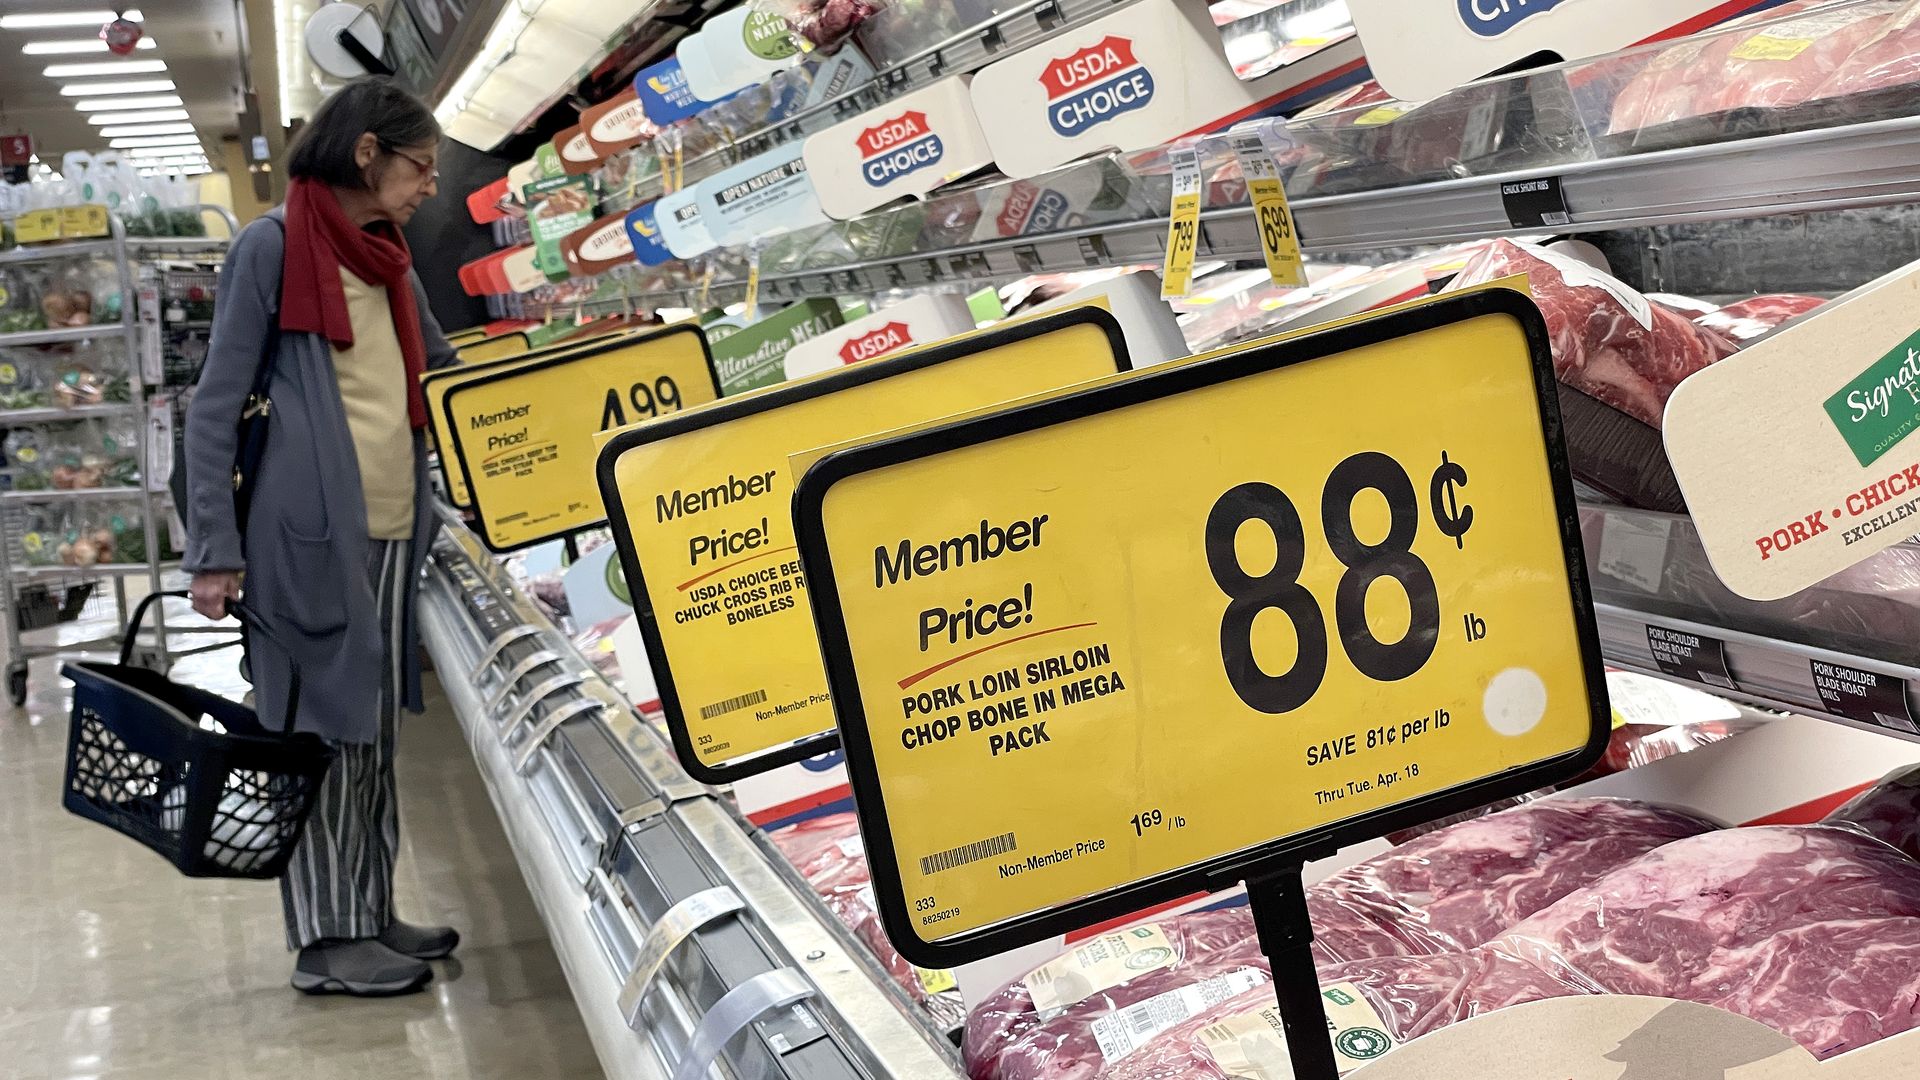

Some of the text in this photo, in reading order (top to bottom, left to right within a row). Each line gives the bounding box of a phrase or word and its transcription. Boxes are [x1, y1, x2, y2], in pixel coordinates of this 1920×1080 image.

[1054, 47, 1123, 89] USDA
[1057, 74, 1150, 129] CHOICE
[867, 117, 918, 153] USDA
[867, 139, 942, 185] CHOICE
[722, 182, 751, 203] OPEN
[749, 168, 787, 192] NATURE
[1503, 180, 1549, 195] CHUCK SHORT RIBS
[1171, 220, 1193, 267] 799
[1261, 206, 1290, 254] 699
[790, 310, 835, 346] MEAT
[851, 329, 901, 361] USDA
[1847, 348, 1920, 422] Signat
[471, 404, 531, 430] Member
[488, 427, 528, 451] Price!
[1874, 420, 1912, 452] QUALITY
[656, 470, 776, 523] Member
[689, 518, 769, 566] Price!
[875, 514, 1048, 588] Member
[1756, 510, 1829, 561] PORK
[675, 600, 721, 624] CHUCK
[724, 588, 767, 610] CROSS
[770, 578, 793, 595] RIB
[690, 582, 726, 602] USDA
[729, 567, 777, 593] CHOICE
[727, 596, 795, 626] BONELESS
[920, 582, 1033, 651] Price!
[1463, 613, 1486, 642] lb
[1649, 627, 1700, 648] PORK SHOULDER
[1651, 639, 1692, 658] BLADE ROAST
[902, 644, 1111, 718] PORK LOIN SIRLOIN
[1813, 662, 1877, 687] PORK SHOULDER
[1816, 676, 1867, 697] BLADE ROAST
[756, 691, 830, 722] Non-Member Price
[901, 671, 1126, 750] CHOP BONE IN MEGA
[1820, 688, 1840, 702] BNLS
[698, 734, 712, 746] 333
[989, 721, 1050, 756] PACK
[1307, 709, 1450, 766] SAVE 81¢ per lb
[1315, 763, 1419, 805] Thru Tue. Apr. 18
[998, 848, 1074, 878] Non-Member
[1076, 838, 1105, 858] Price
[915, 896, 936, 912] 333
[922, 907, 961, 926] 88250219
